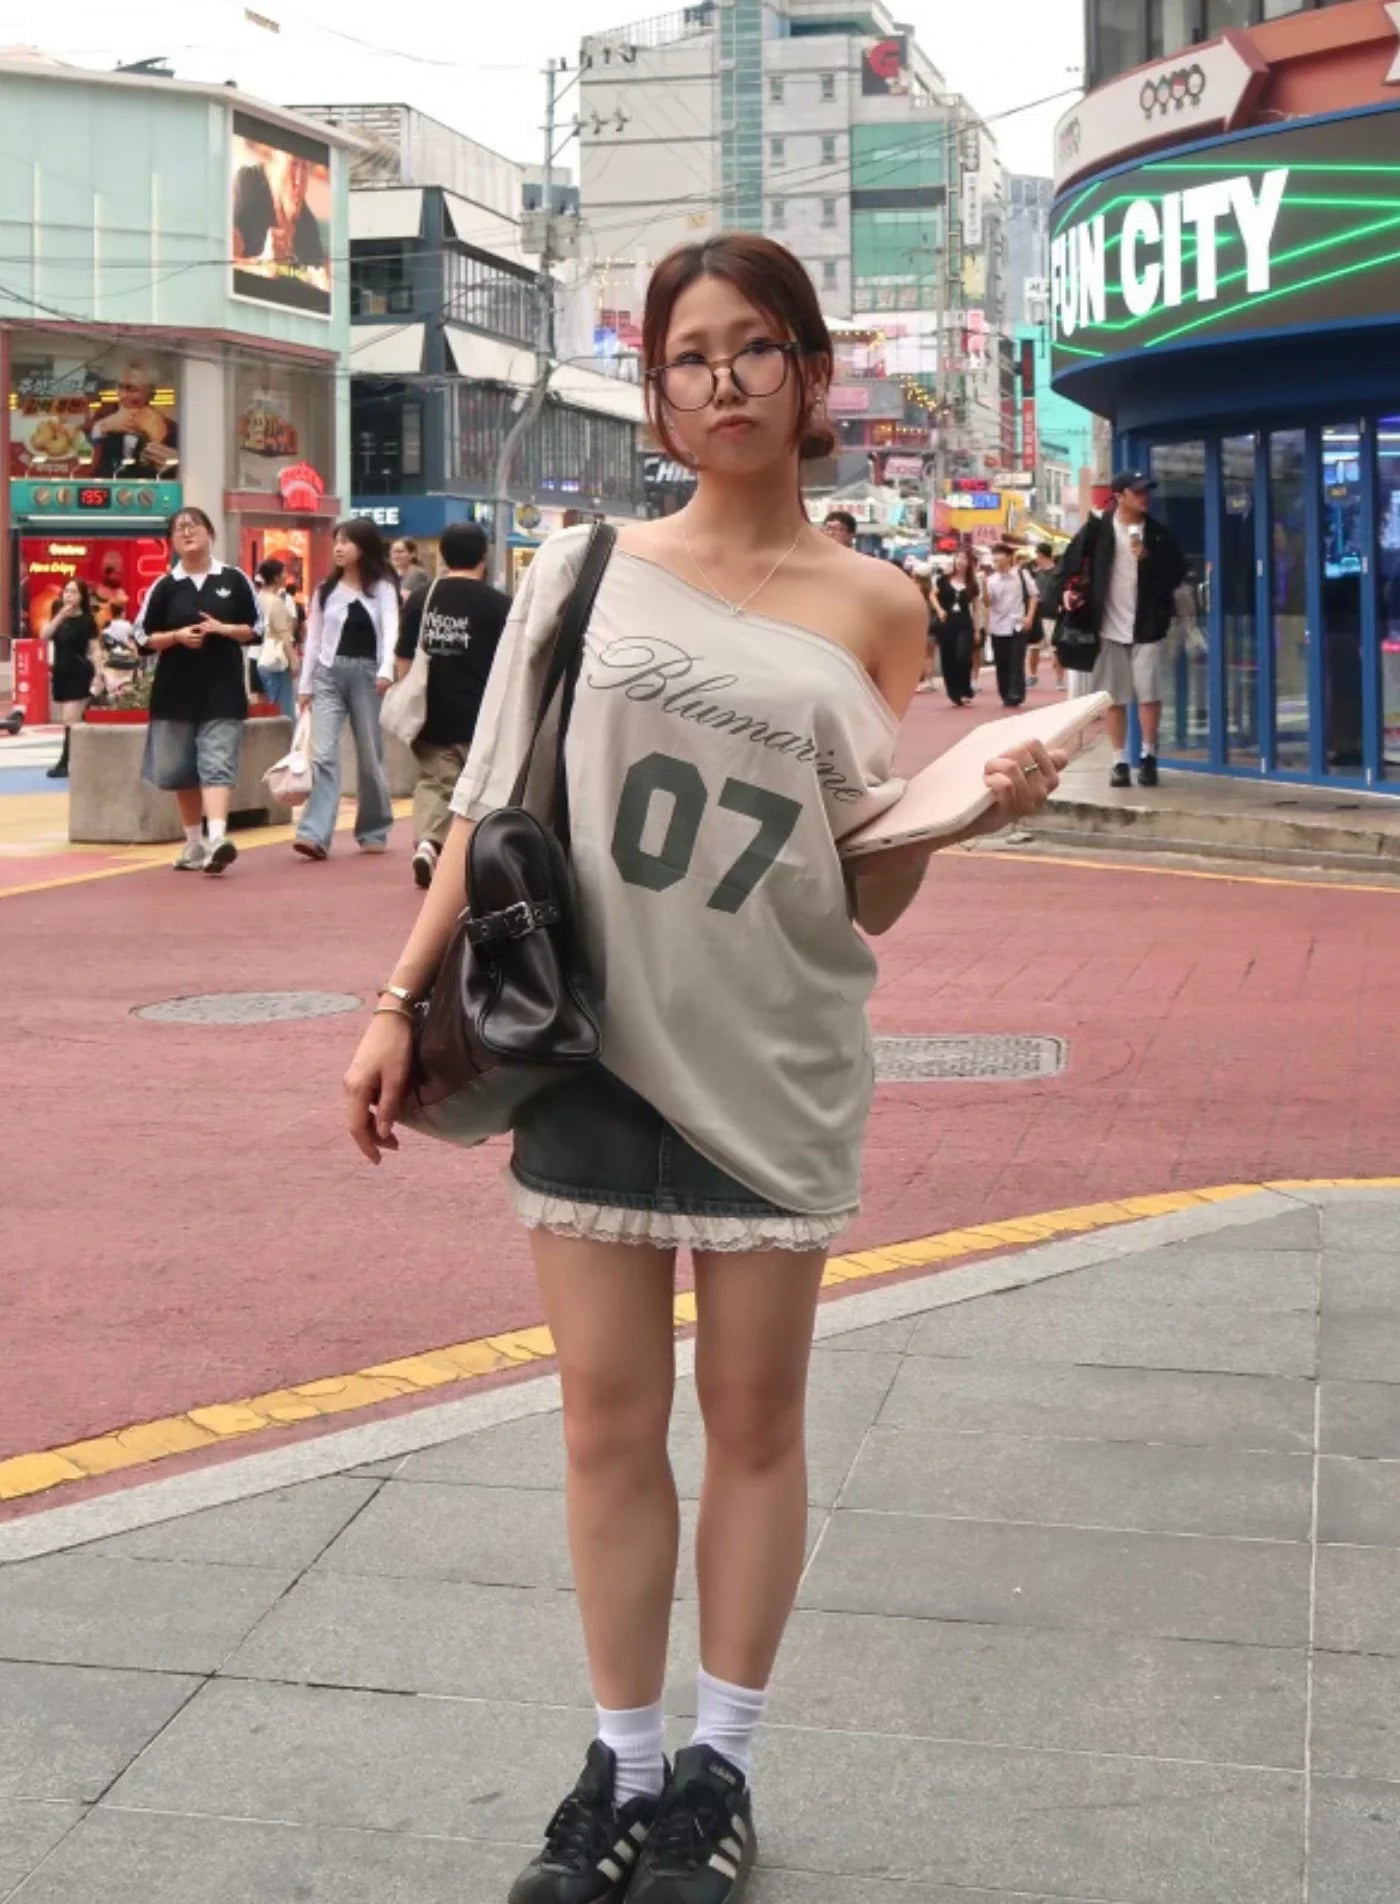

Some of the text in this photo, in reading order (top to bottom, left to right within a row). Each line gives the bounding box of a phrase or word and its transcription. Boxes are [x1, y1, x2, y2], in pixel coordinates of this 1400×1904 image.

[1051, 214, 1106, 341] FUN
[1120, 168, 1289, 318] CITY
[587, 636, 864, 802] Blumarine
[611, 752, 803, 914] 07
